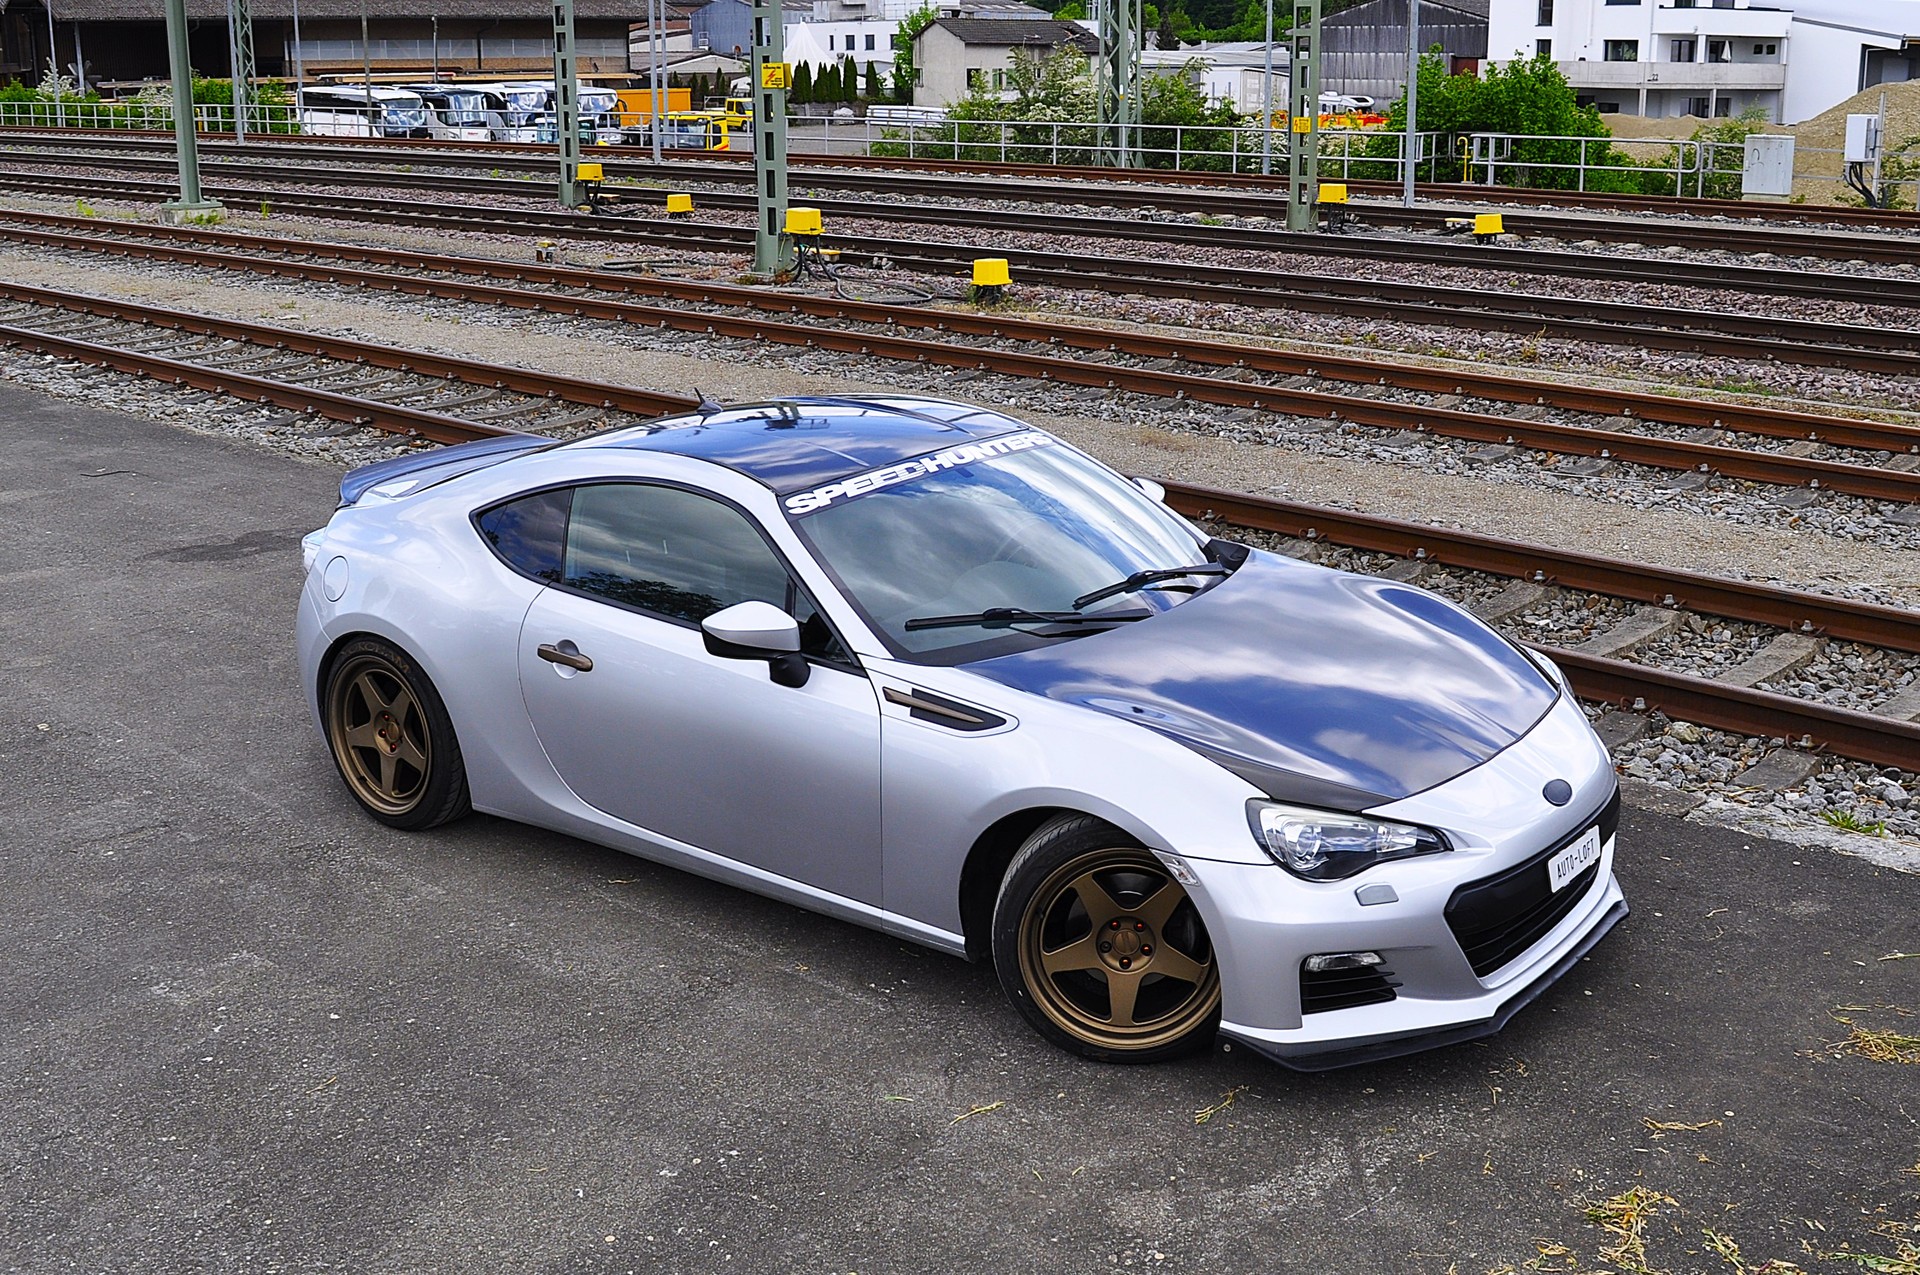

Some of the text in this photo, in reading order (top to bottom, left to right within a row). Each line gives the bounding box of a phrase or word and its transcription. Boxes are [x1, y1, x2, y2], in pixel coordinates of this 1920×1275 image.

[784, 432, 1054, 515] SPEEDHUNTERS
[340, 641, 411, 674] YOKOHAM
[1556, 837, 1595, 880] AUTO-LOFT
